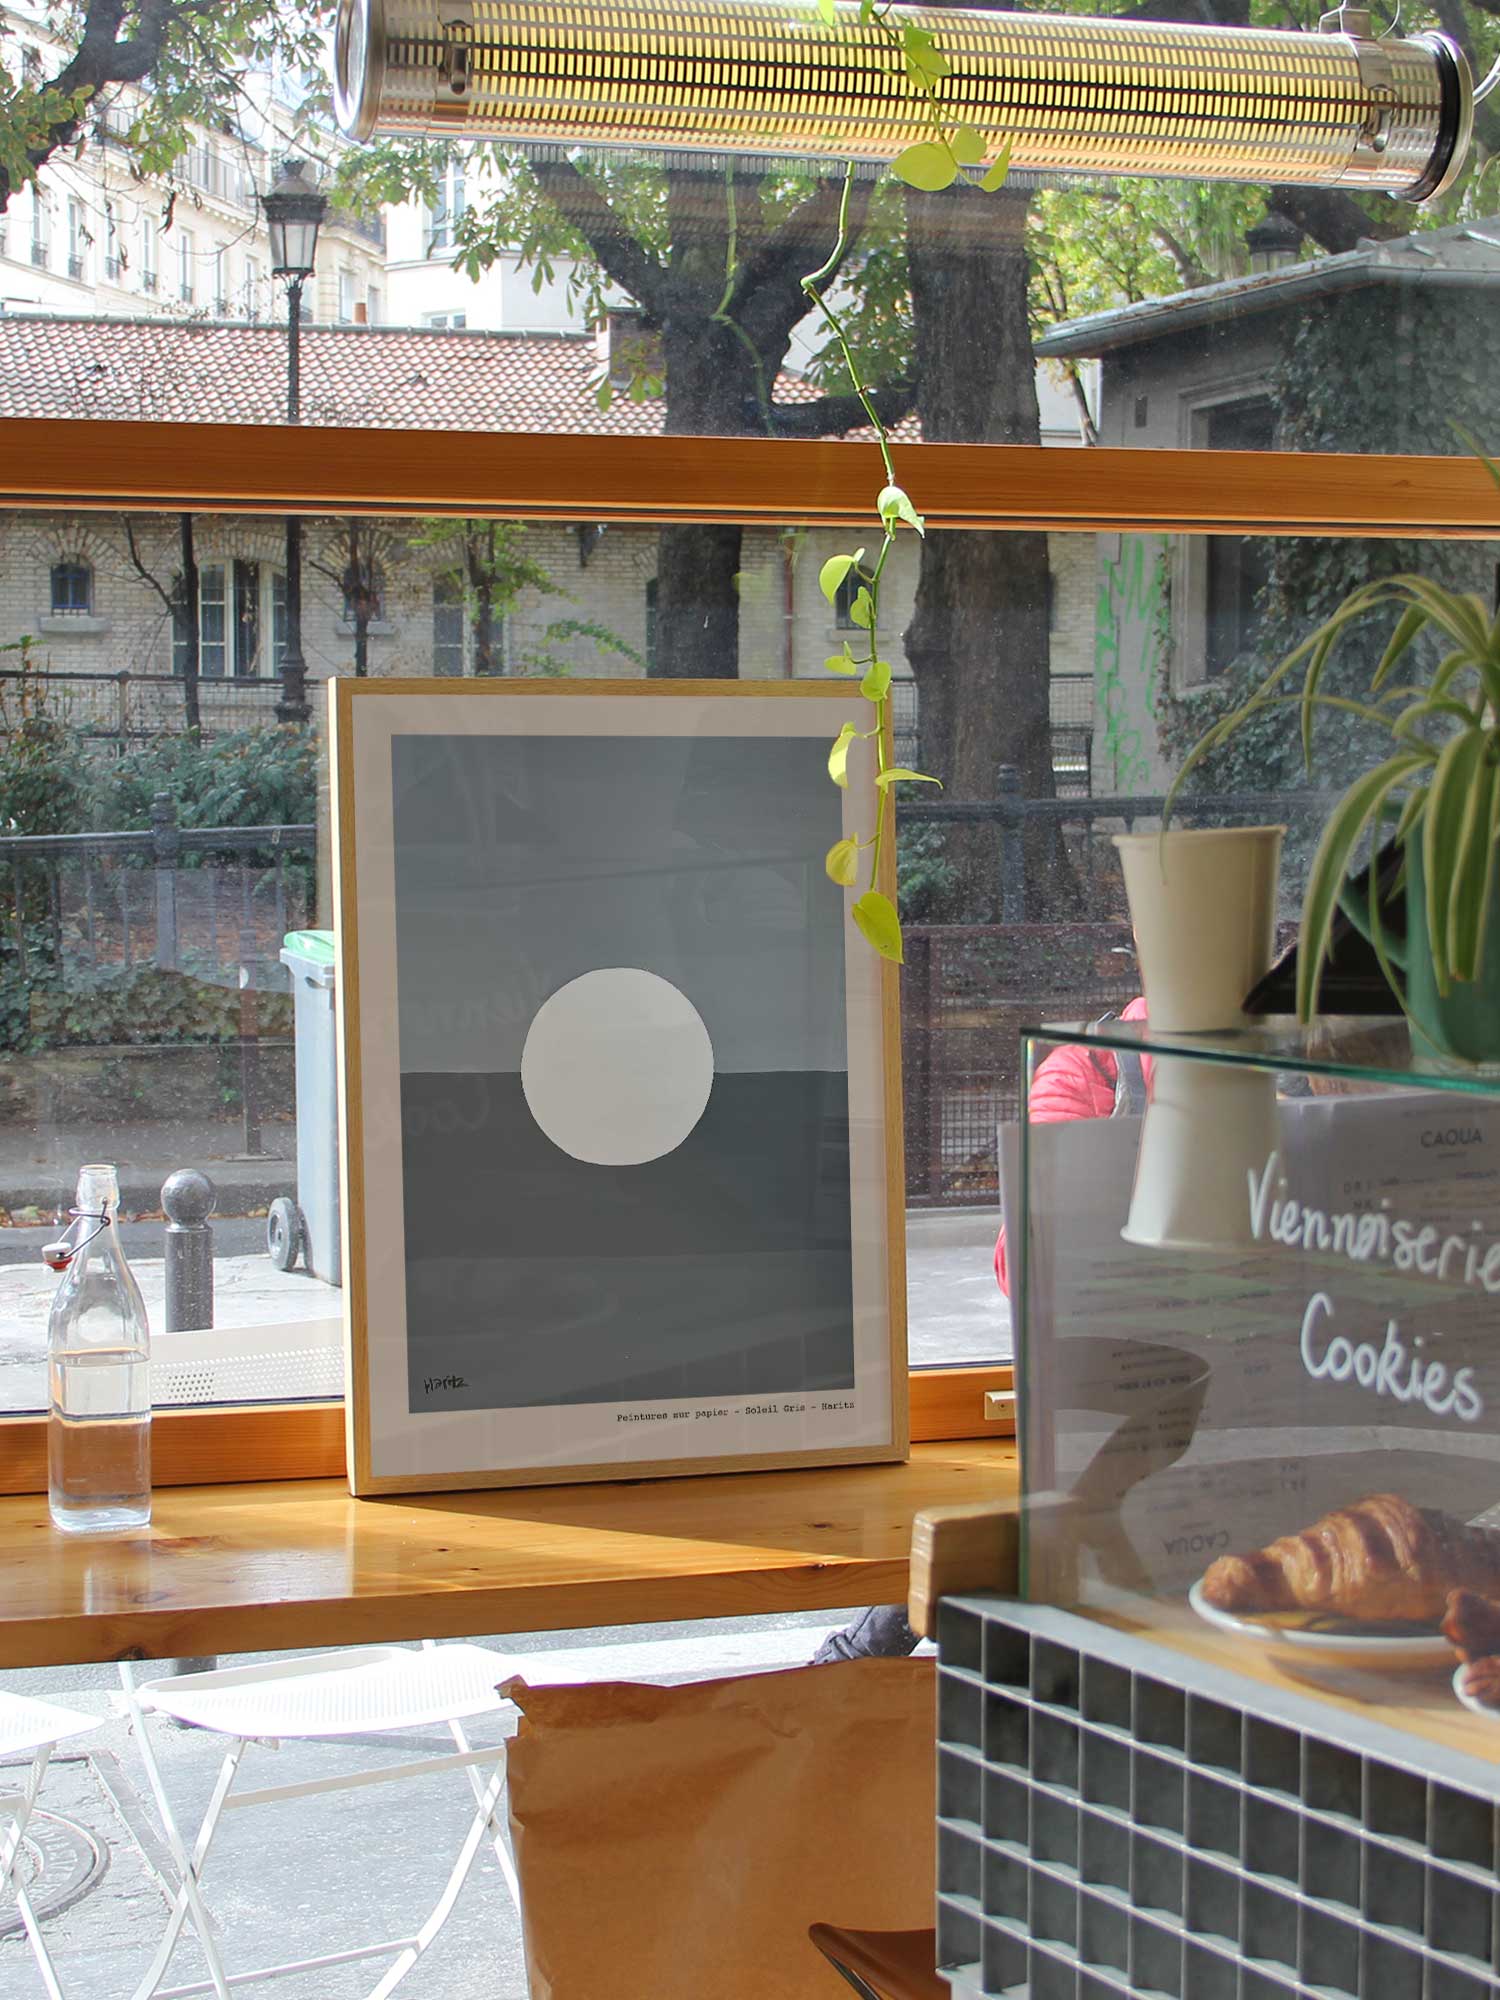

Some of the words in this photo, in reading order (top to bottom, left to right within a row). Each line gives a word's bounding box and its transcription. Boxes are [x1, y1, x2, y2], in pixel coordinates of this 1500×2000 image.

[1300, 1291, 1485, 1423] Cookies
[616, 1412, 668, 1422] Peintures
[673, 1411, 690, 1419] sur
[695, 1408, 729, 1419] papier
[745, 1405, 778, 1415] Soleil
[783, 1404, 806, 1412] Gris
